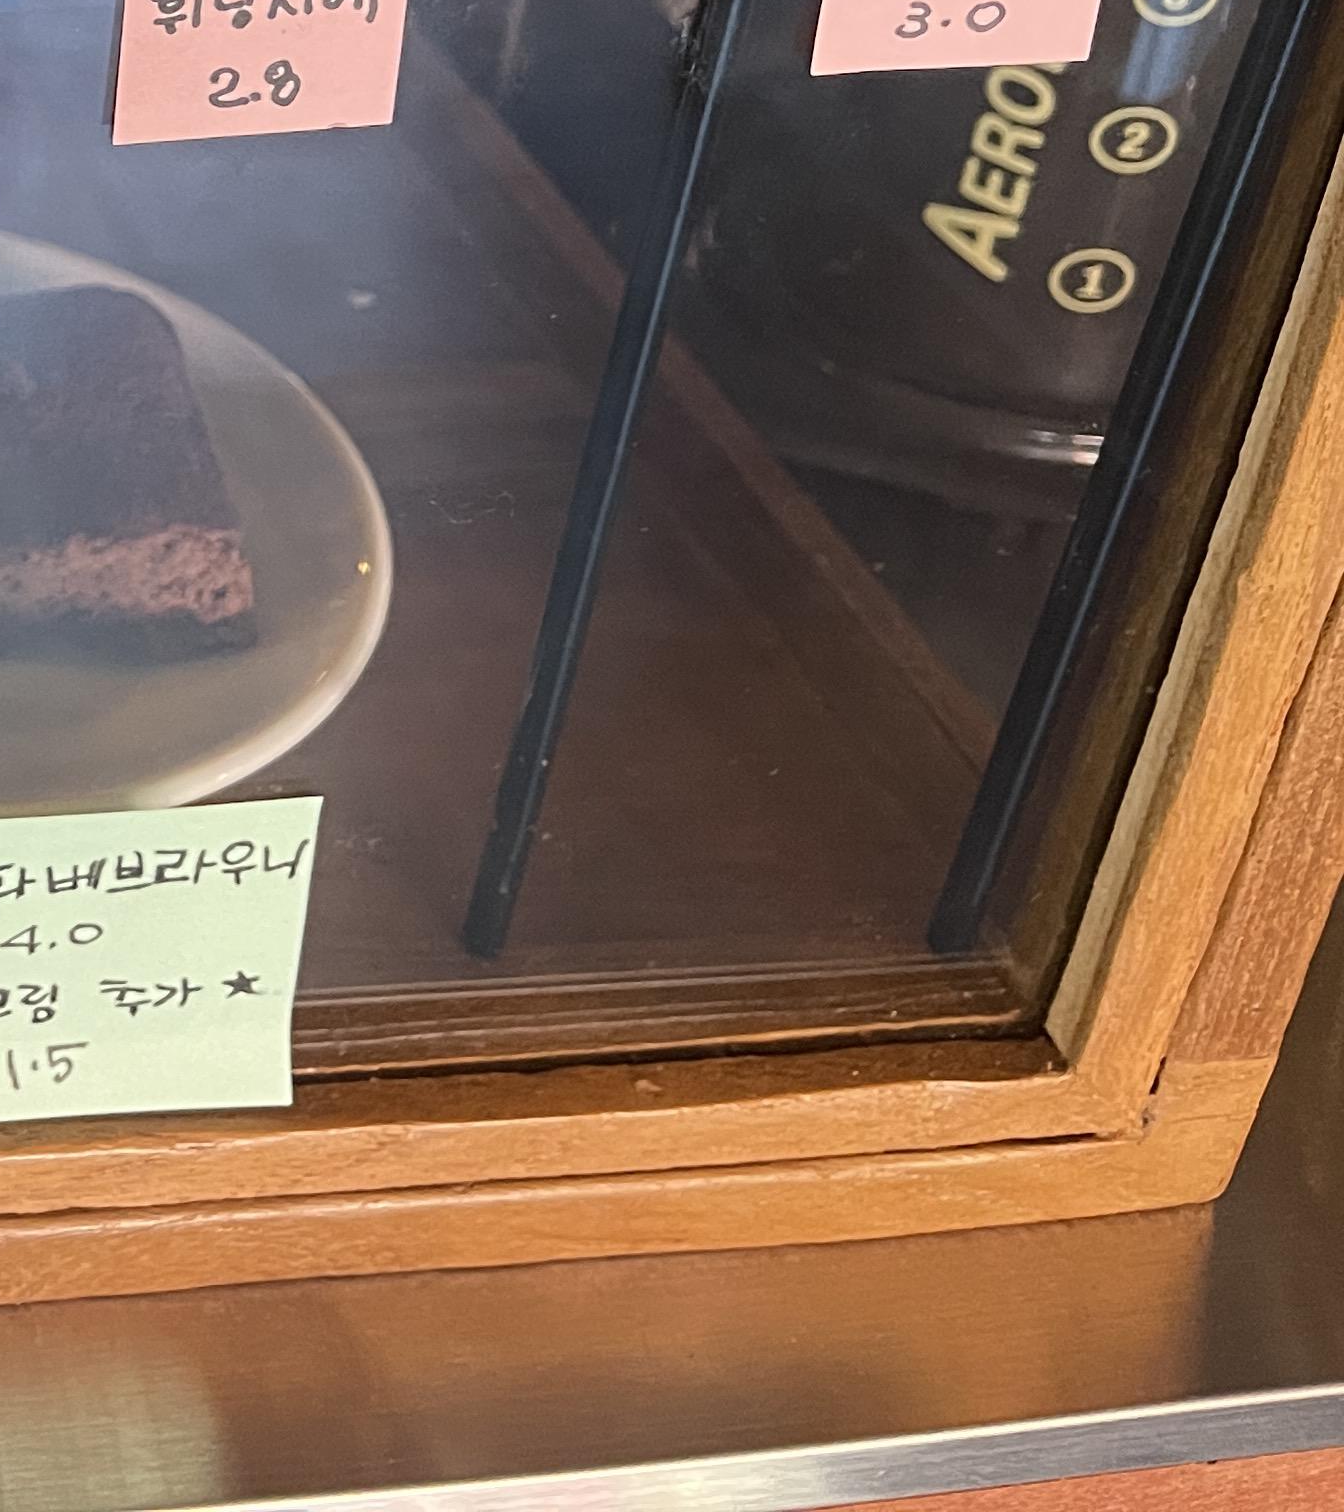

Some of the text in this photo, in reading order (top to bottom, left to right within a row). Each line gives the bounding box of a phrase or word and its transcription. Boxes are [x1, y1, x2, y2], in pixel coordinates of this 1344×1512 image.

[895, 0, 1006, 39] 3.0
[208, 59, 301, 108] 2.8
[922, 62, 1068, 283] AERO
[99, 977, 203, 1017] 추가
[6, 1041, 89, 1090] 1.5
